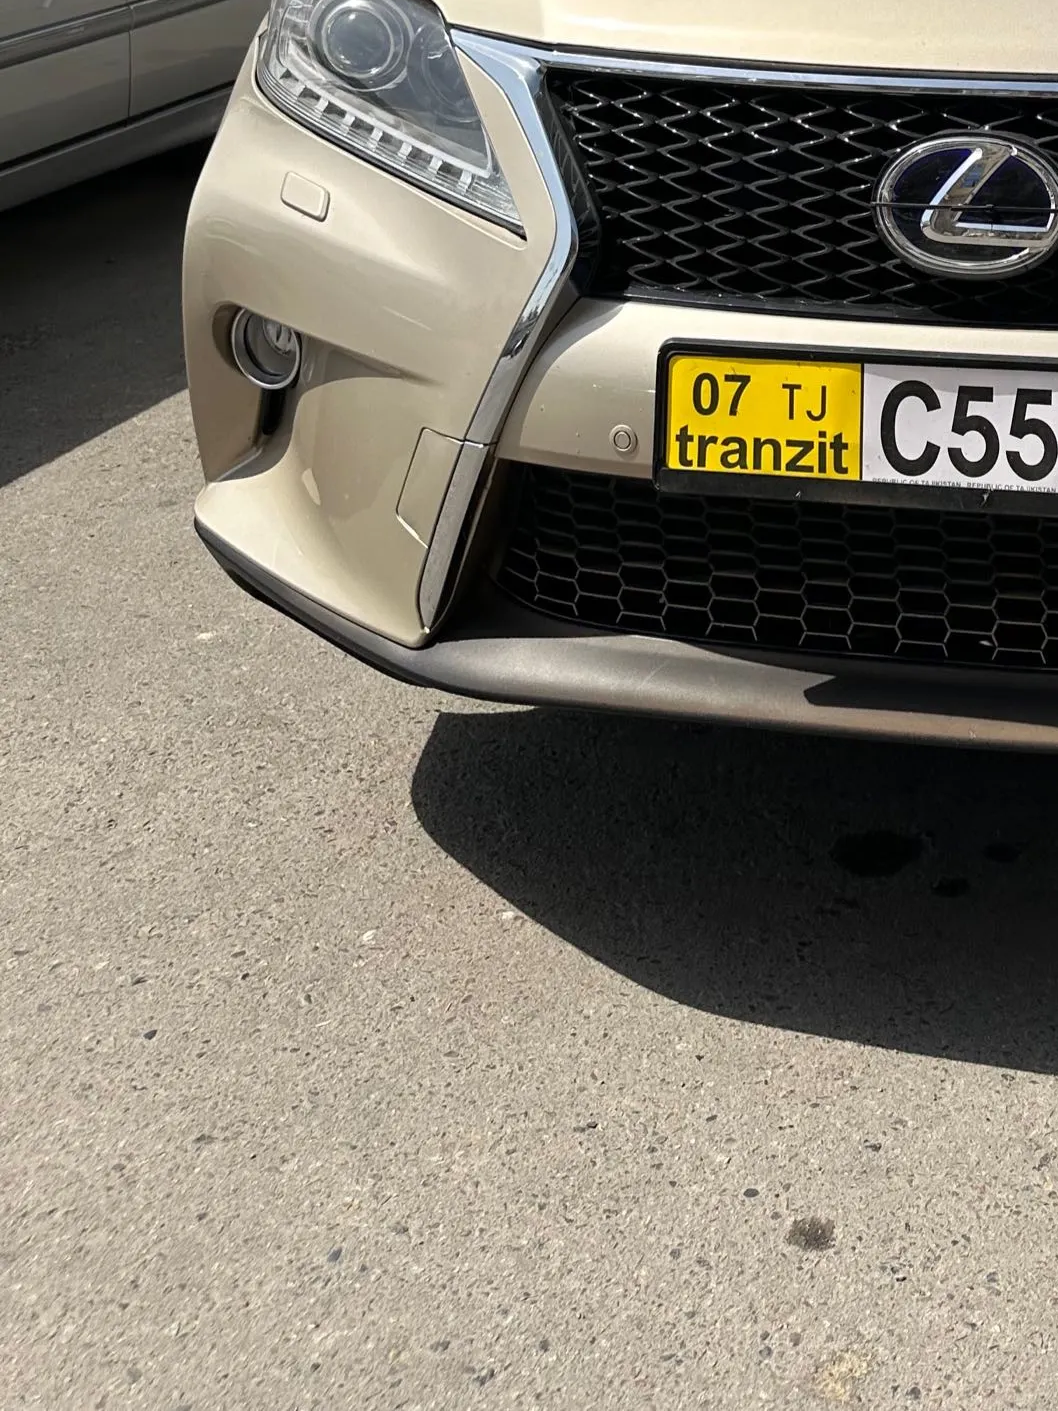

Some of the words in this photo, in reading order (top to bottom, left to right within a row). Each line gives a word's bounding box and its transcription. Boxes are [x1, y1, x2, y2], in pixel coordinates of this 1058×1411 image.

[692, 373, 751, 416] 07
[782, 384, 827, 421] TJ
[676, 424, 849, 475] tranzit
